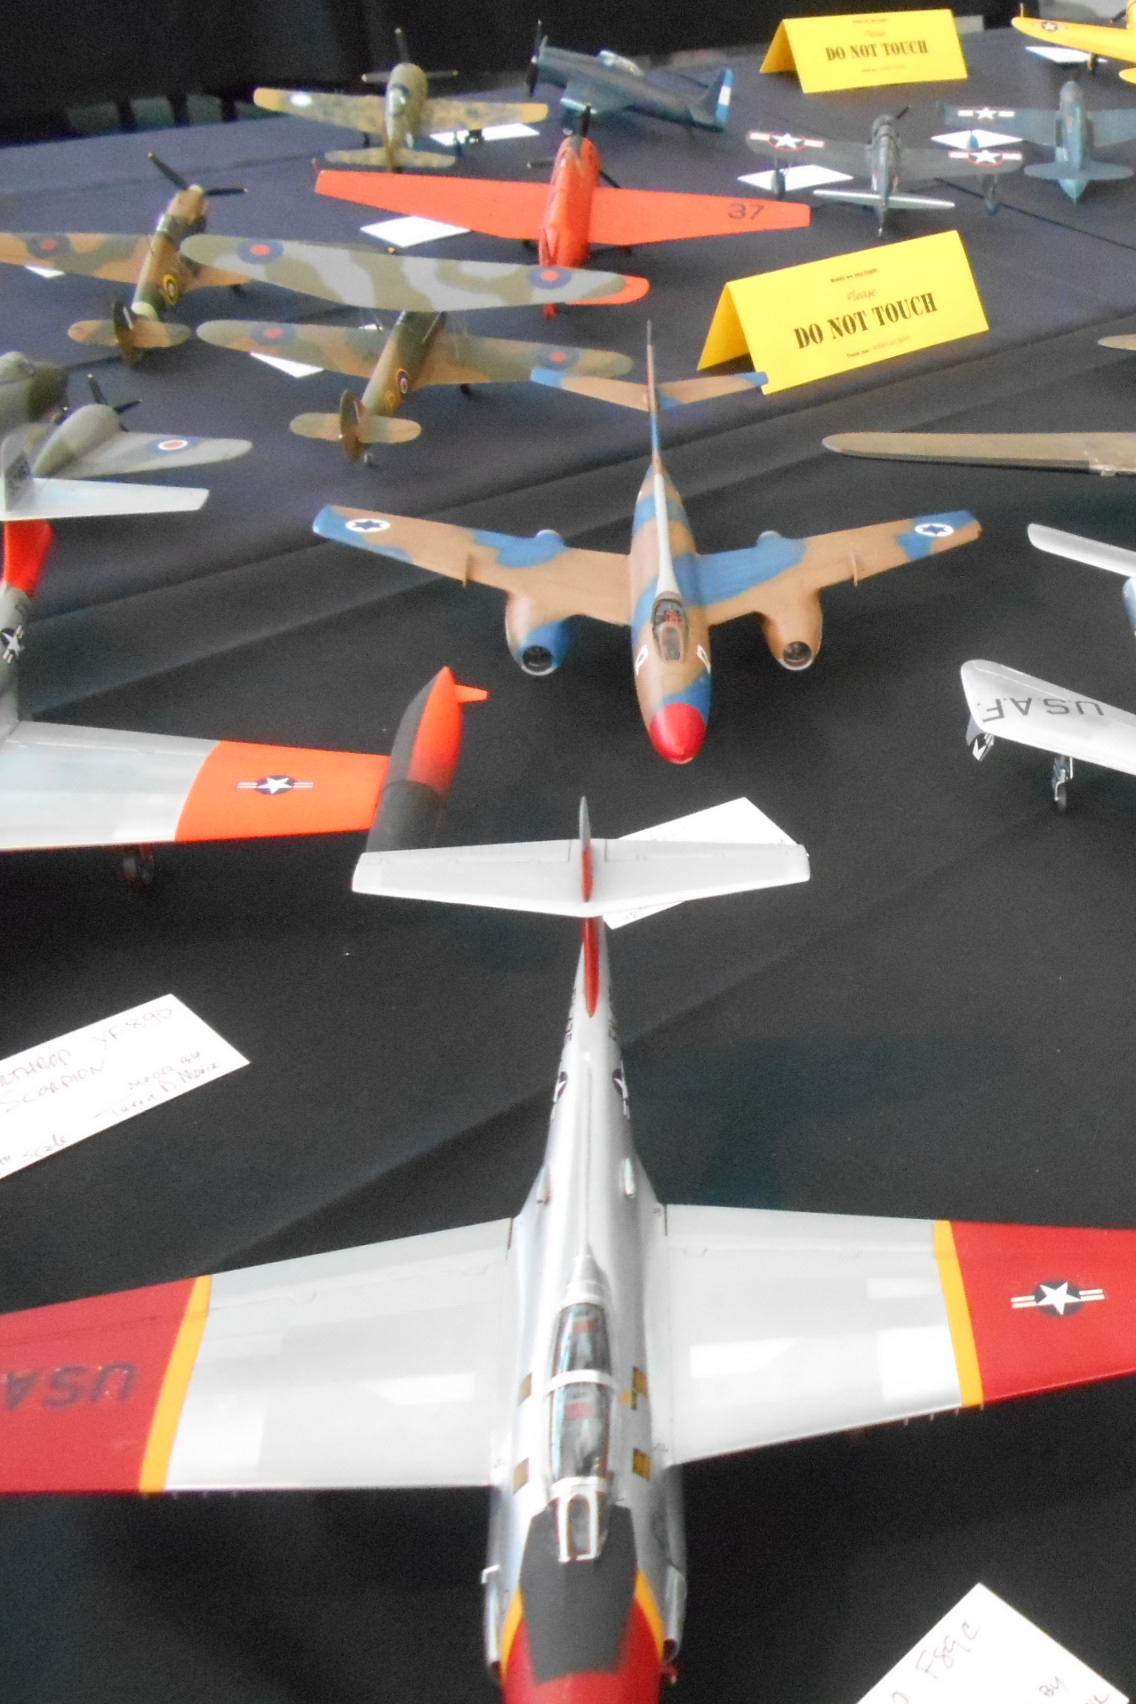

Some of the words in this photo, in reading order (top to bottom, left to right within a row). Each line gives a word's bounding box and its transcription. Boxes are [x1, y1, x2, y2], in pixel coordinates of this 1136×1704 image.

[825, 46, 846, 62] DO
[849, 43, 879, 59] NOT
[880, 39, 929, 57] TOUCH
[728, 203, 765, 220] 37
[794, 323, 824, 349] DO
[827, 310, 870, 340] NOT
[871, 292, 938, 328] TOUCH
